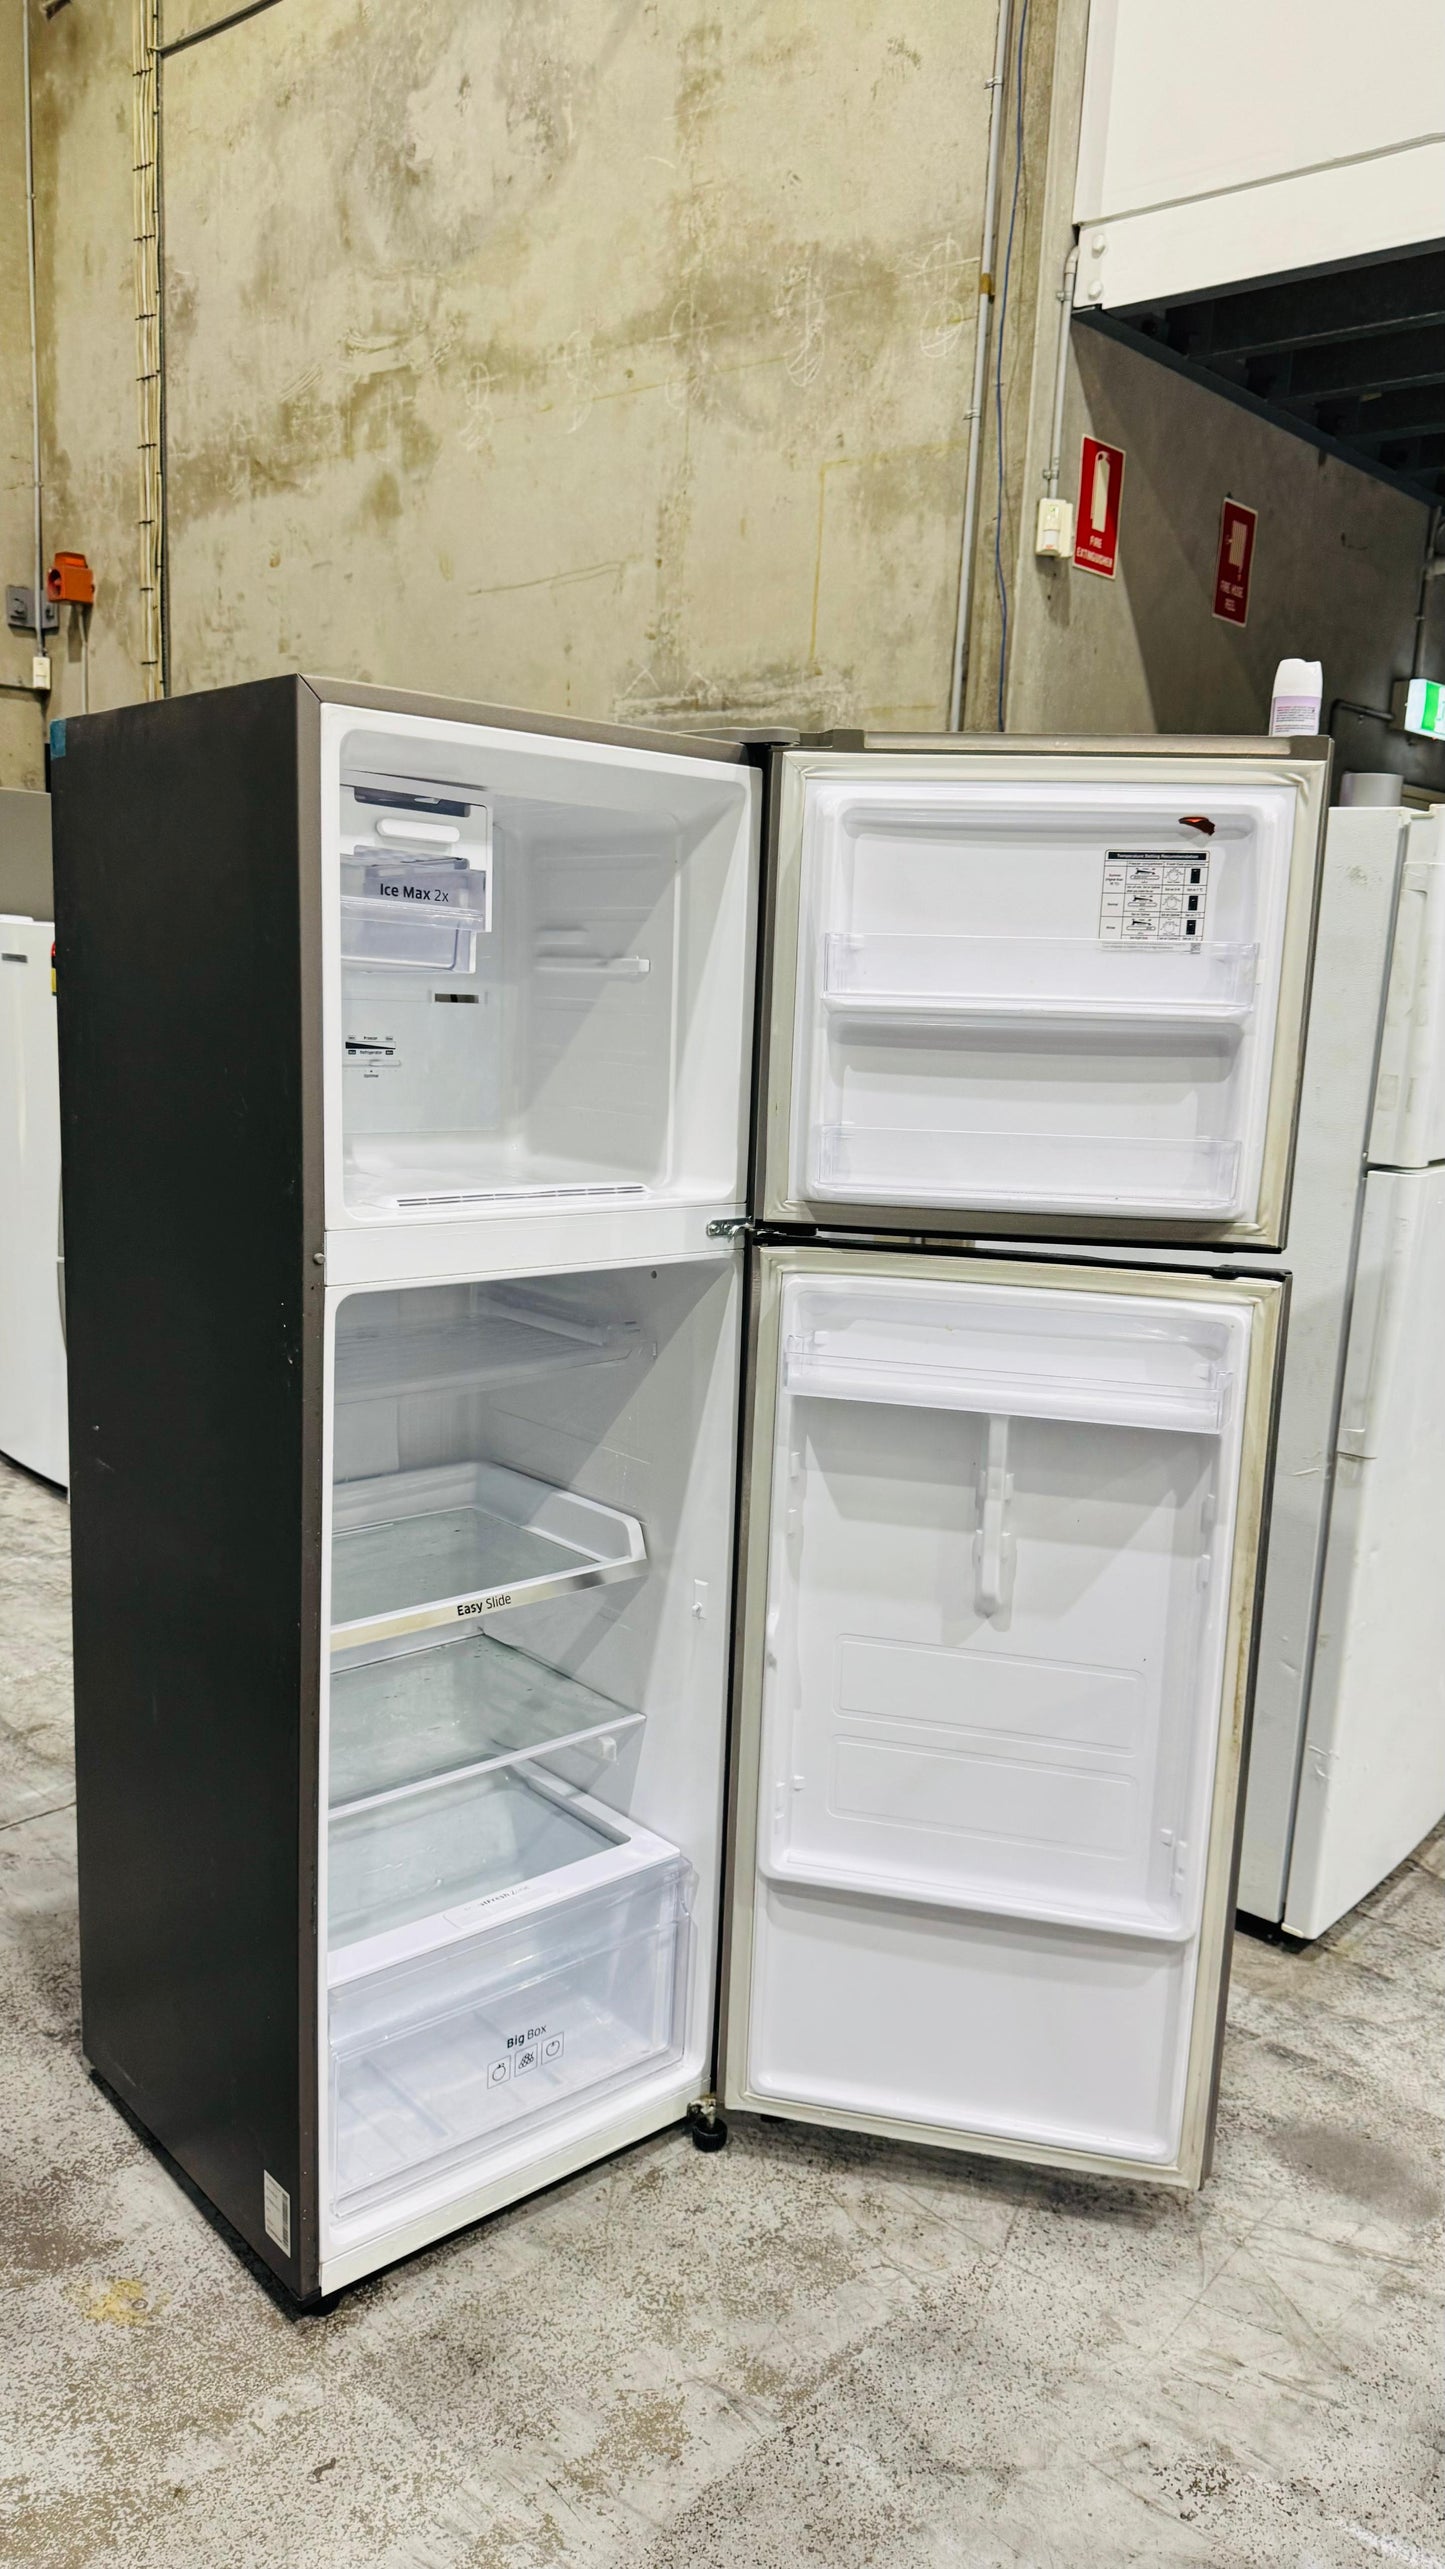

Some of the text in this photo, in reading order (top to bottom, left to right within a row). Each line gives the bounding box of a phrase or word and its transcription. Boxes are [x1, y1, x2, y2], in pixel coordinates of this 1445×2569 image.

[380, 883, 449, 902] Ice Max 2x
[457, 1594, 512, 1616] Easy Slide
[507, 2025, 547, 2049] Big Box
